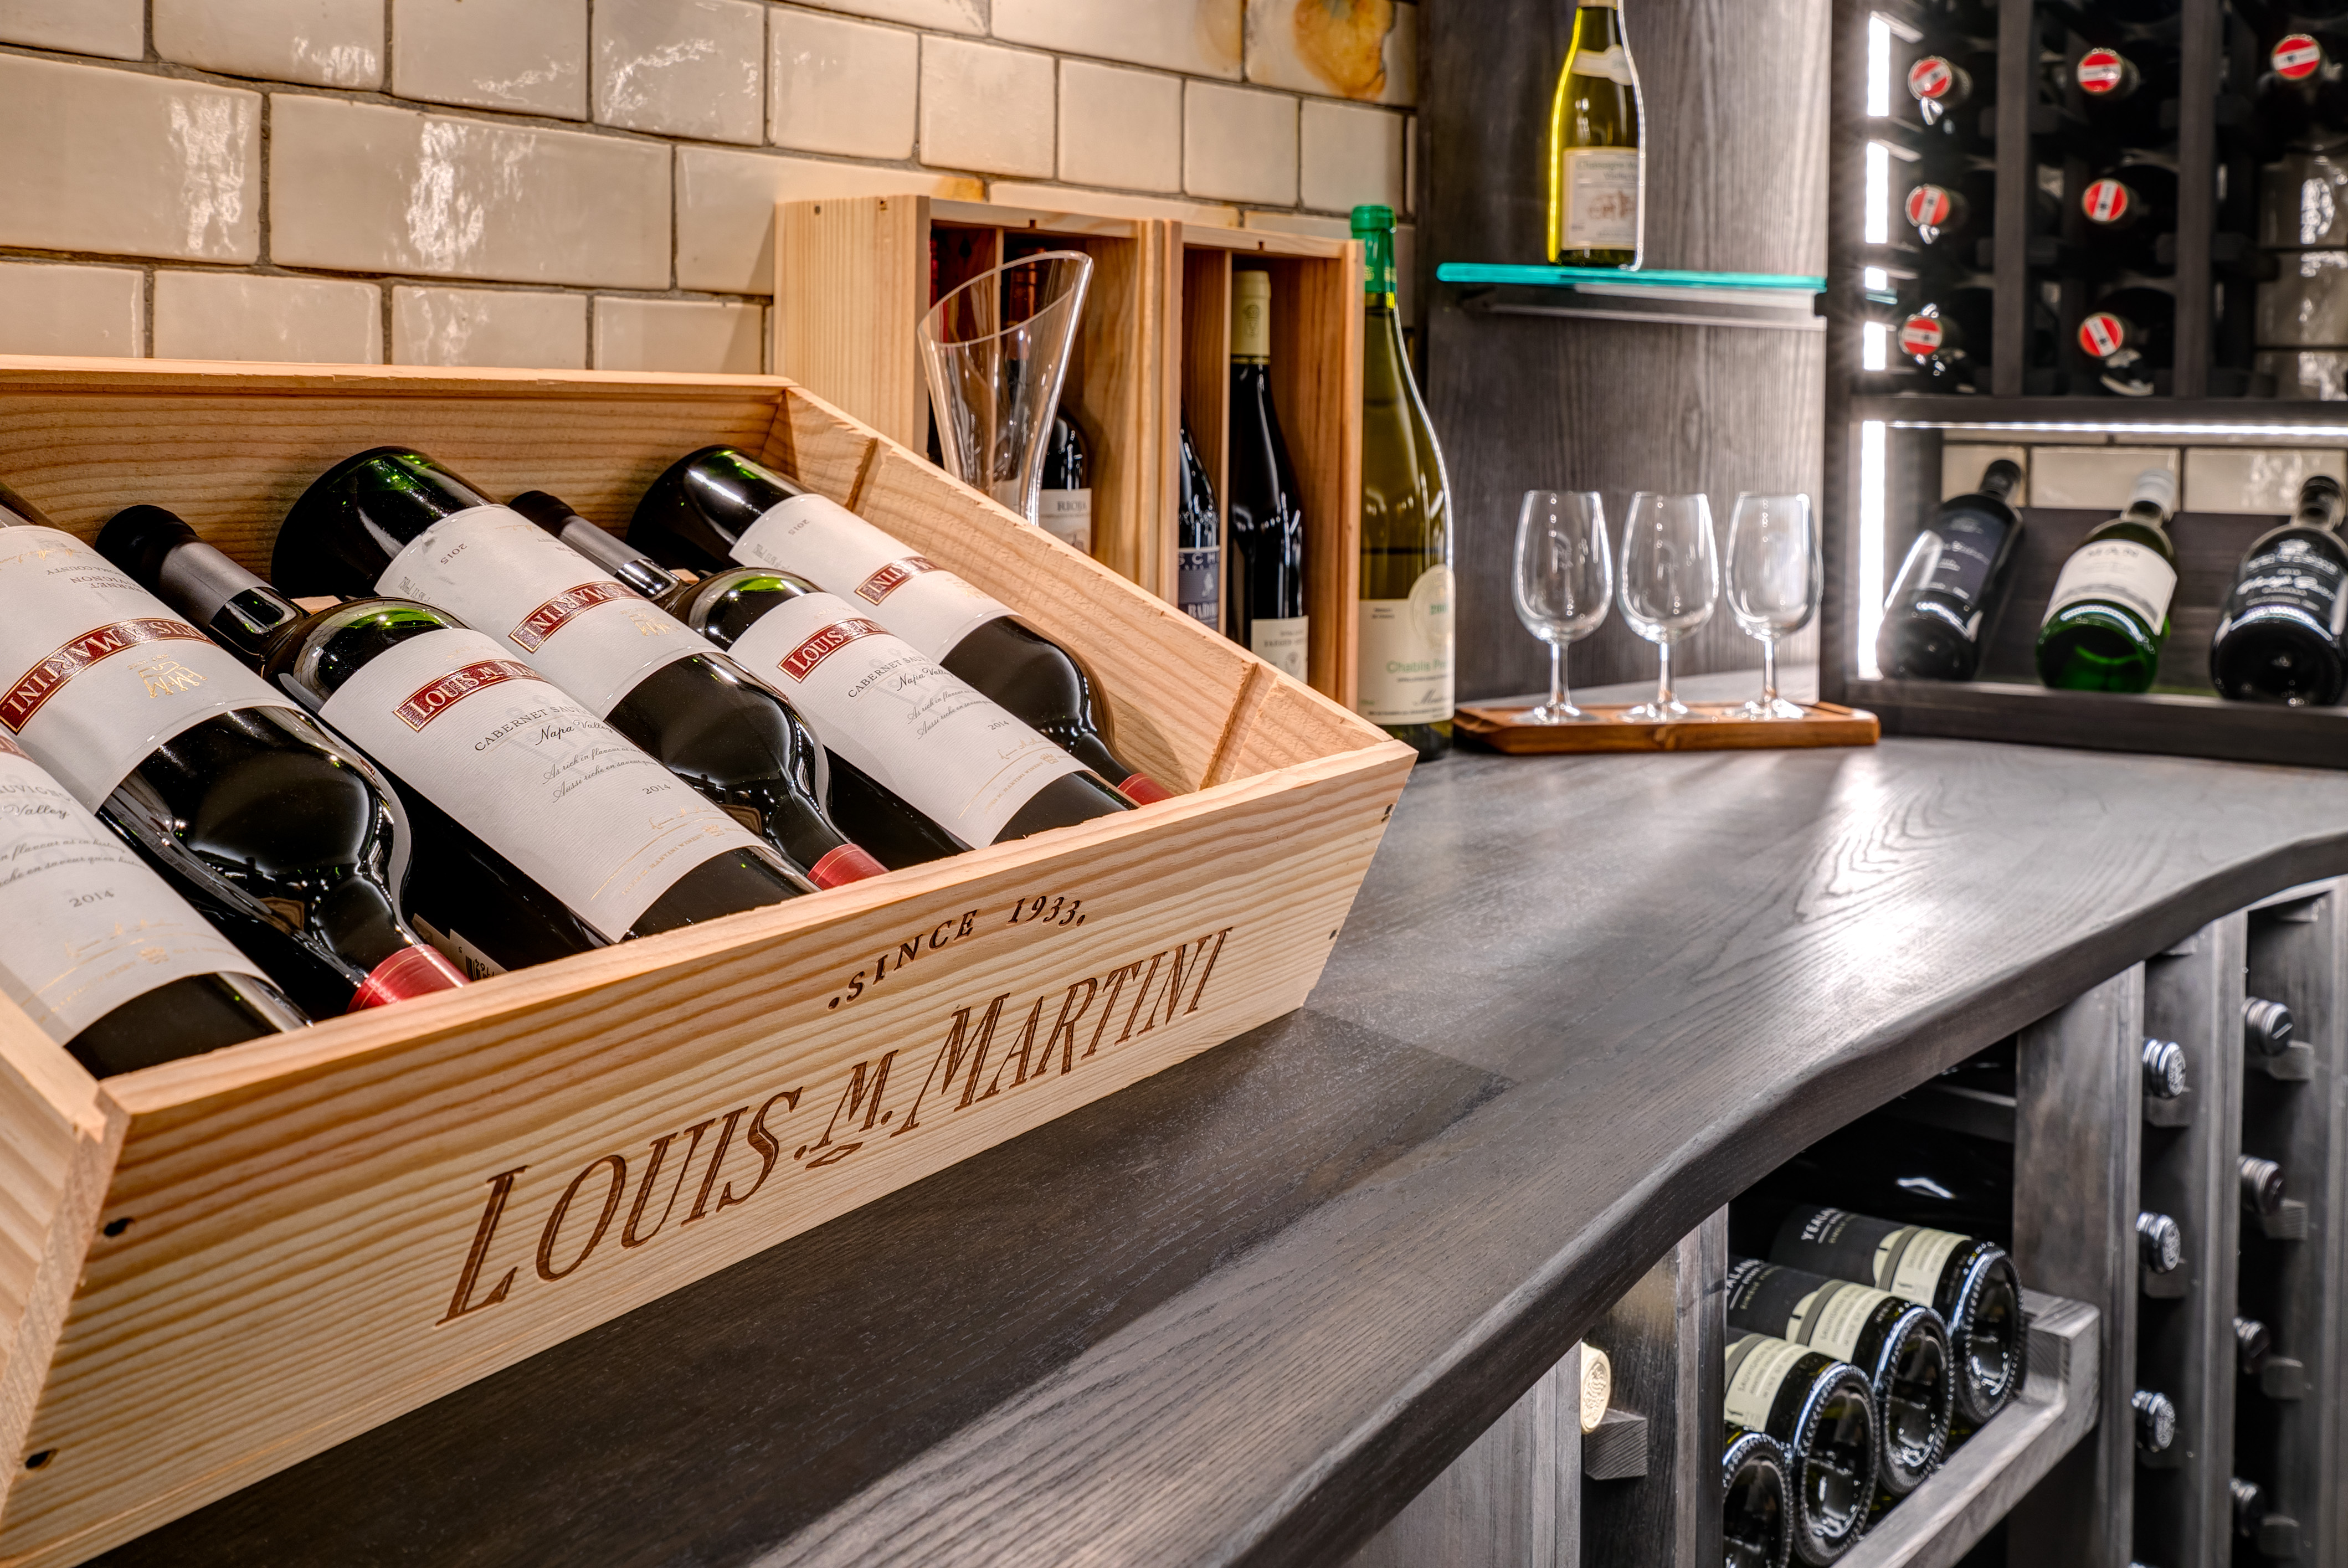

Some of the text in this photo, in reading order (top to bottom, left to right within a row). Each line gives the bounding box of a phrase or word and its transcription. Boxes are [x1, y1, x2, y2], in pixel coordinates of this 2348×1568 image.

[788, 519, 810, 535] 2015
[440, 543, 467, 564] 2015
[46, 565, 93, 575] COUNTY
[524, 584, 614, 638] MARTINI
[147, 621, 208, 641] OUIS
[788, 630, 844, 672] LOUIS
[7, 628, 126, 715] MARTINI
[848, 660, 902, 698] CABERNET
[896, 667, 955, 691] Napa Valley
[1386, 660, 1431, 674] Chablis
[409, 673, 480, 718] LOUIS
[907, 706, 921, 724] As
[922, 698, 934, 712] rich
[917, 718, 940, 740] Aussi
[939, 706, 955, 720] riche
[475, 708, 548, 752] CABERNET
[535, 719, 614, 746] Napa Valley
[988, 719, 1010, 731] 2014
[542, 764, 561, 785] As
[562, 754, 579, 770] rich
[592, 748, 621, 760] flavour
[1003, 773, 1025, 793] MARTINI
[1025, 761, 1044, 775] WINERY
[552, 779, 583, 803] Aussi
[583, 765, 605, 781] riche
[641, 784, 672, 795] 2014
[2, 803, 70, 820] Valley
[12, 840, 60, 861] flavour
[648, 846, 680, 870] MARTINI
[678, 833, 705, 848] WINERY
[27, 865, 43, 876] en
[44, 856, 85, 870] saveur
[69, 890, 115, 908] 2014
[435, 1086, 804, 1327] LOUIS
[889, 926, 1234, 1139] MARTINI
